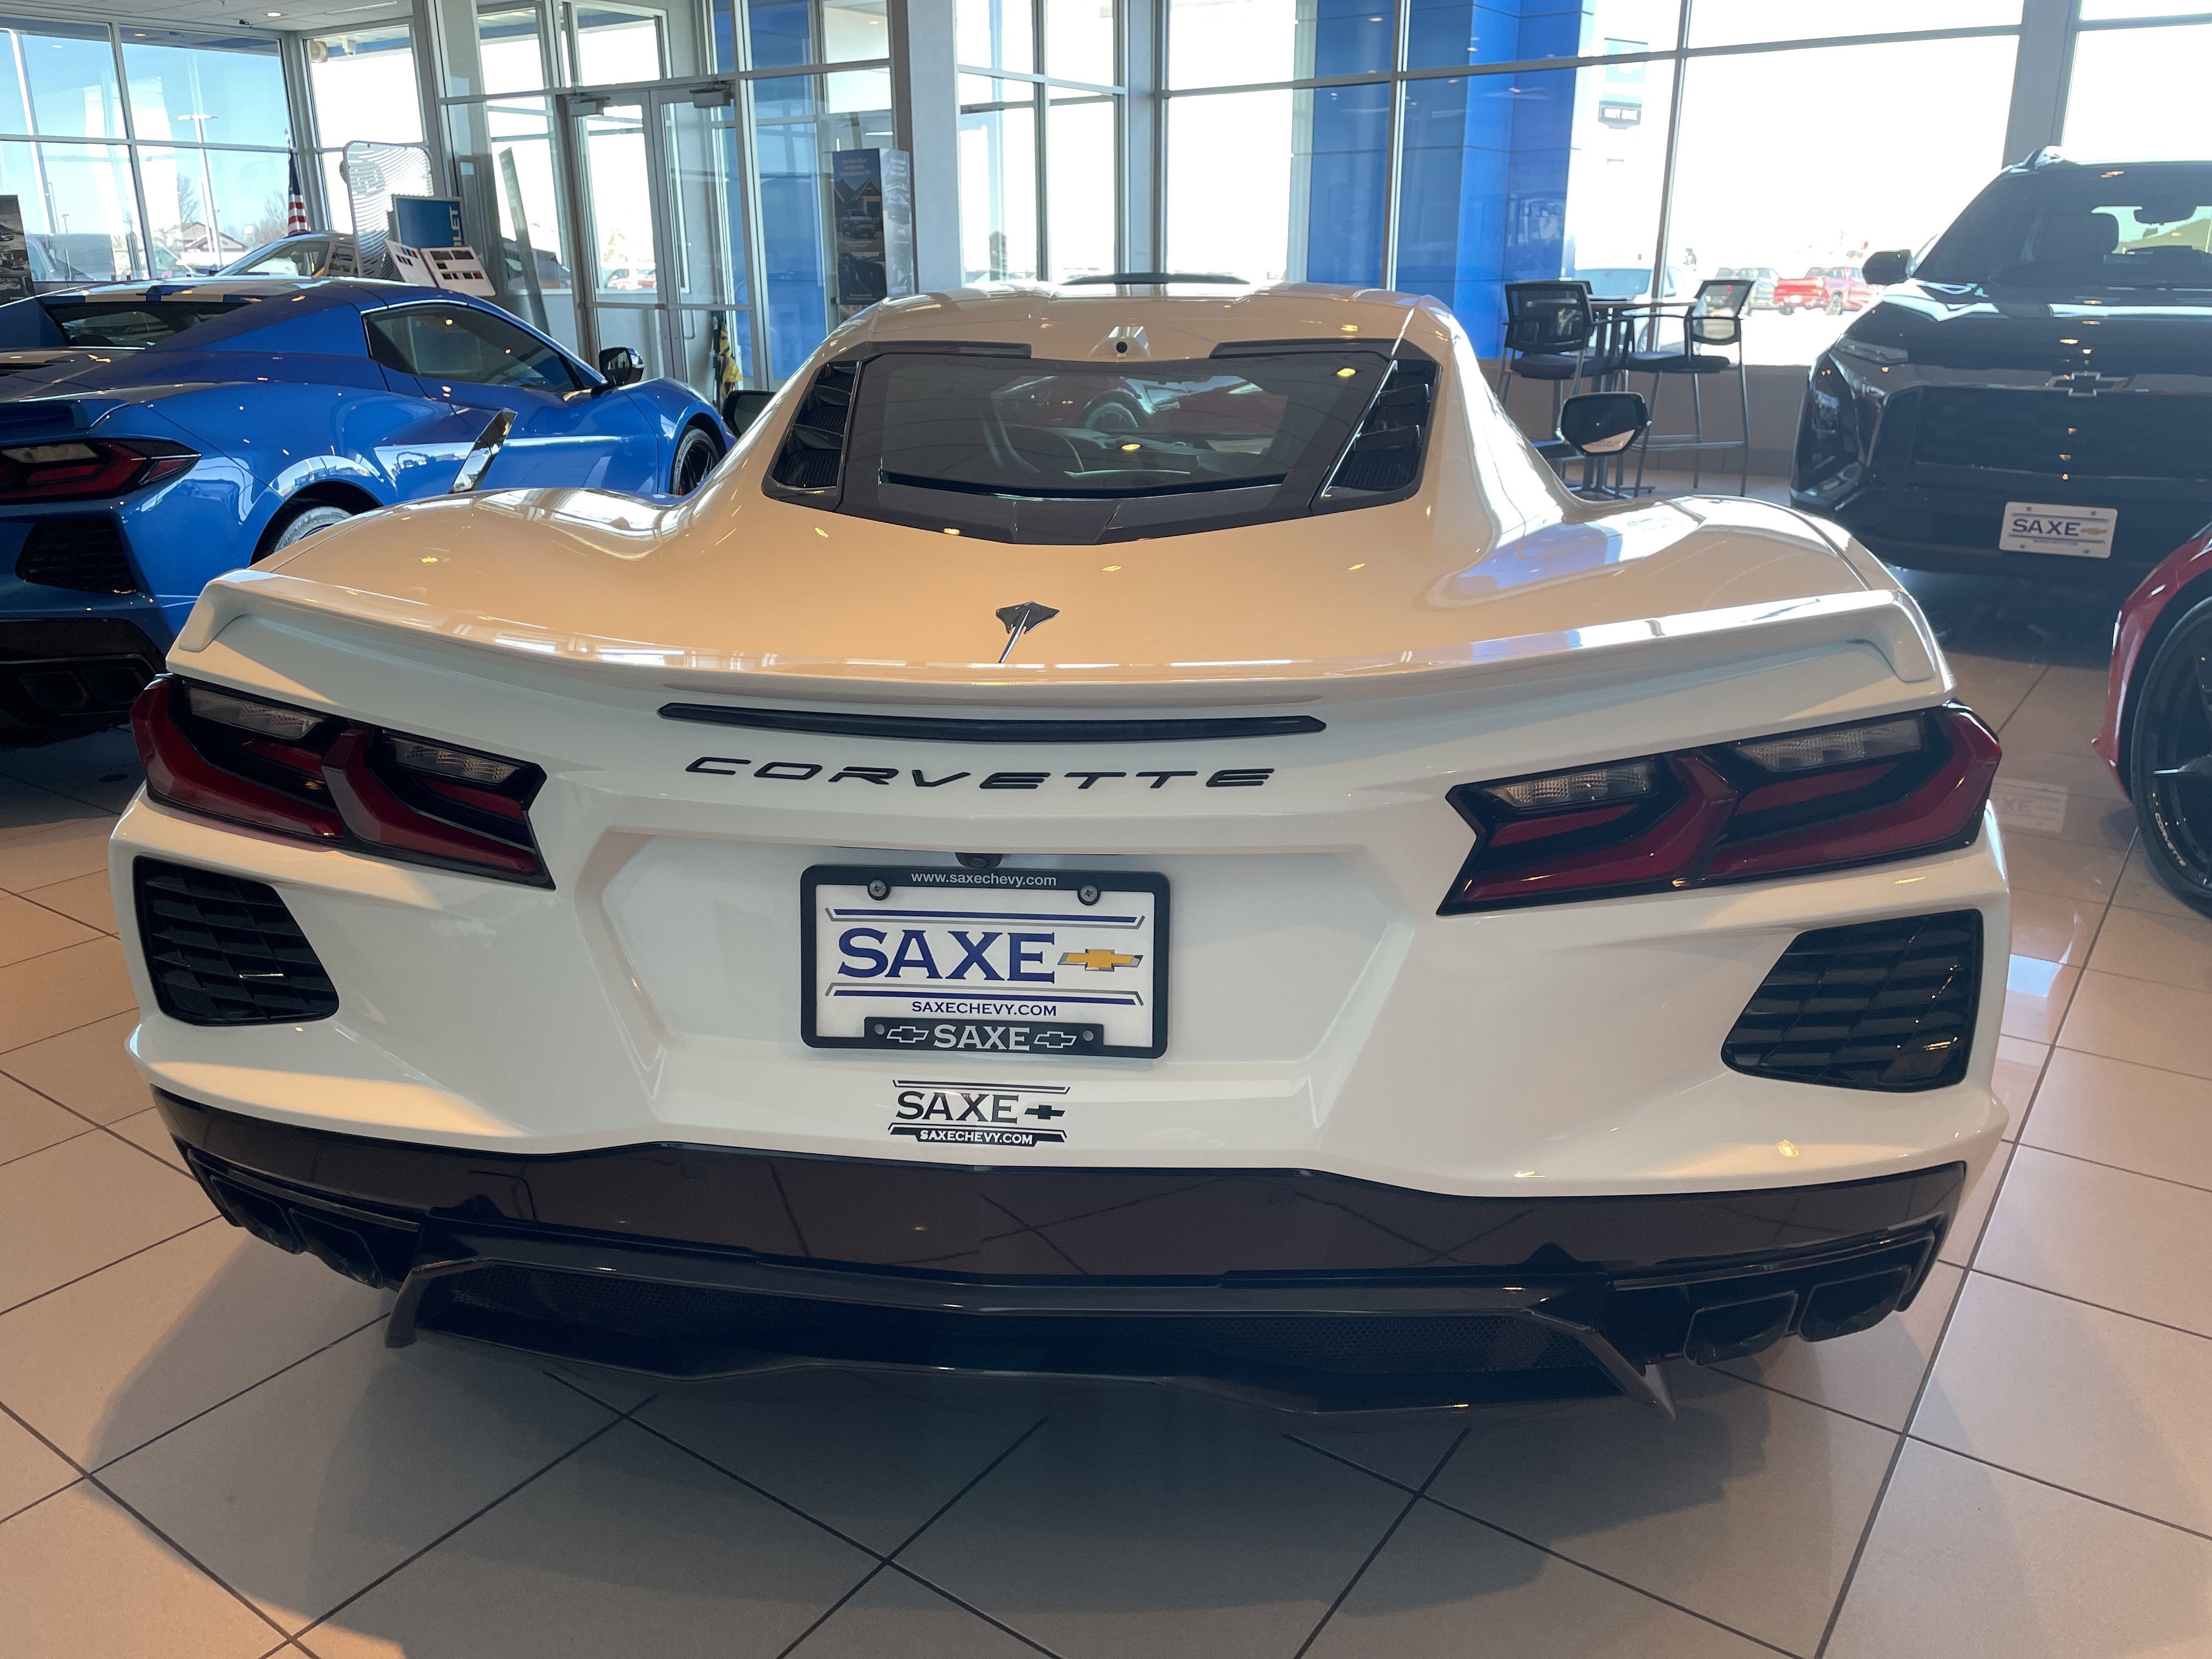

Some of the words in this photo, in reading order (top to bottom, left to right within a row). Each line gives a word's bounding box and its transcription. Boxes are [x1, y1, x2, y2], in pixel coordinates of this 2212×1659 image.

[2012, 518, 2081, 537] SAXE
[685, 755, 1276, 789] CORVETTE
[911, 873, 1057, 888] www.saxechevy.com
[837, 927, 1055, 984] SAXE
[911, 1001, 1057, 1017] SAXECHEVY.COM
[933, 1024, 1030, 1052] SAXE
[895, 1090, 1019, 1124] SAXE
[919, 1130, 1034, 1145] SAXECHEVY.COM
